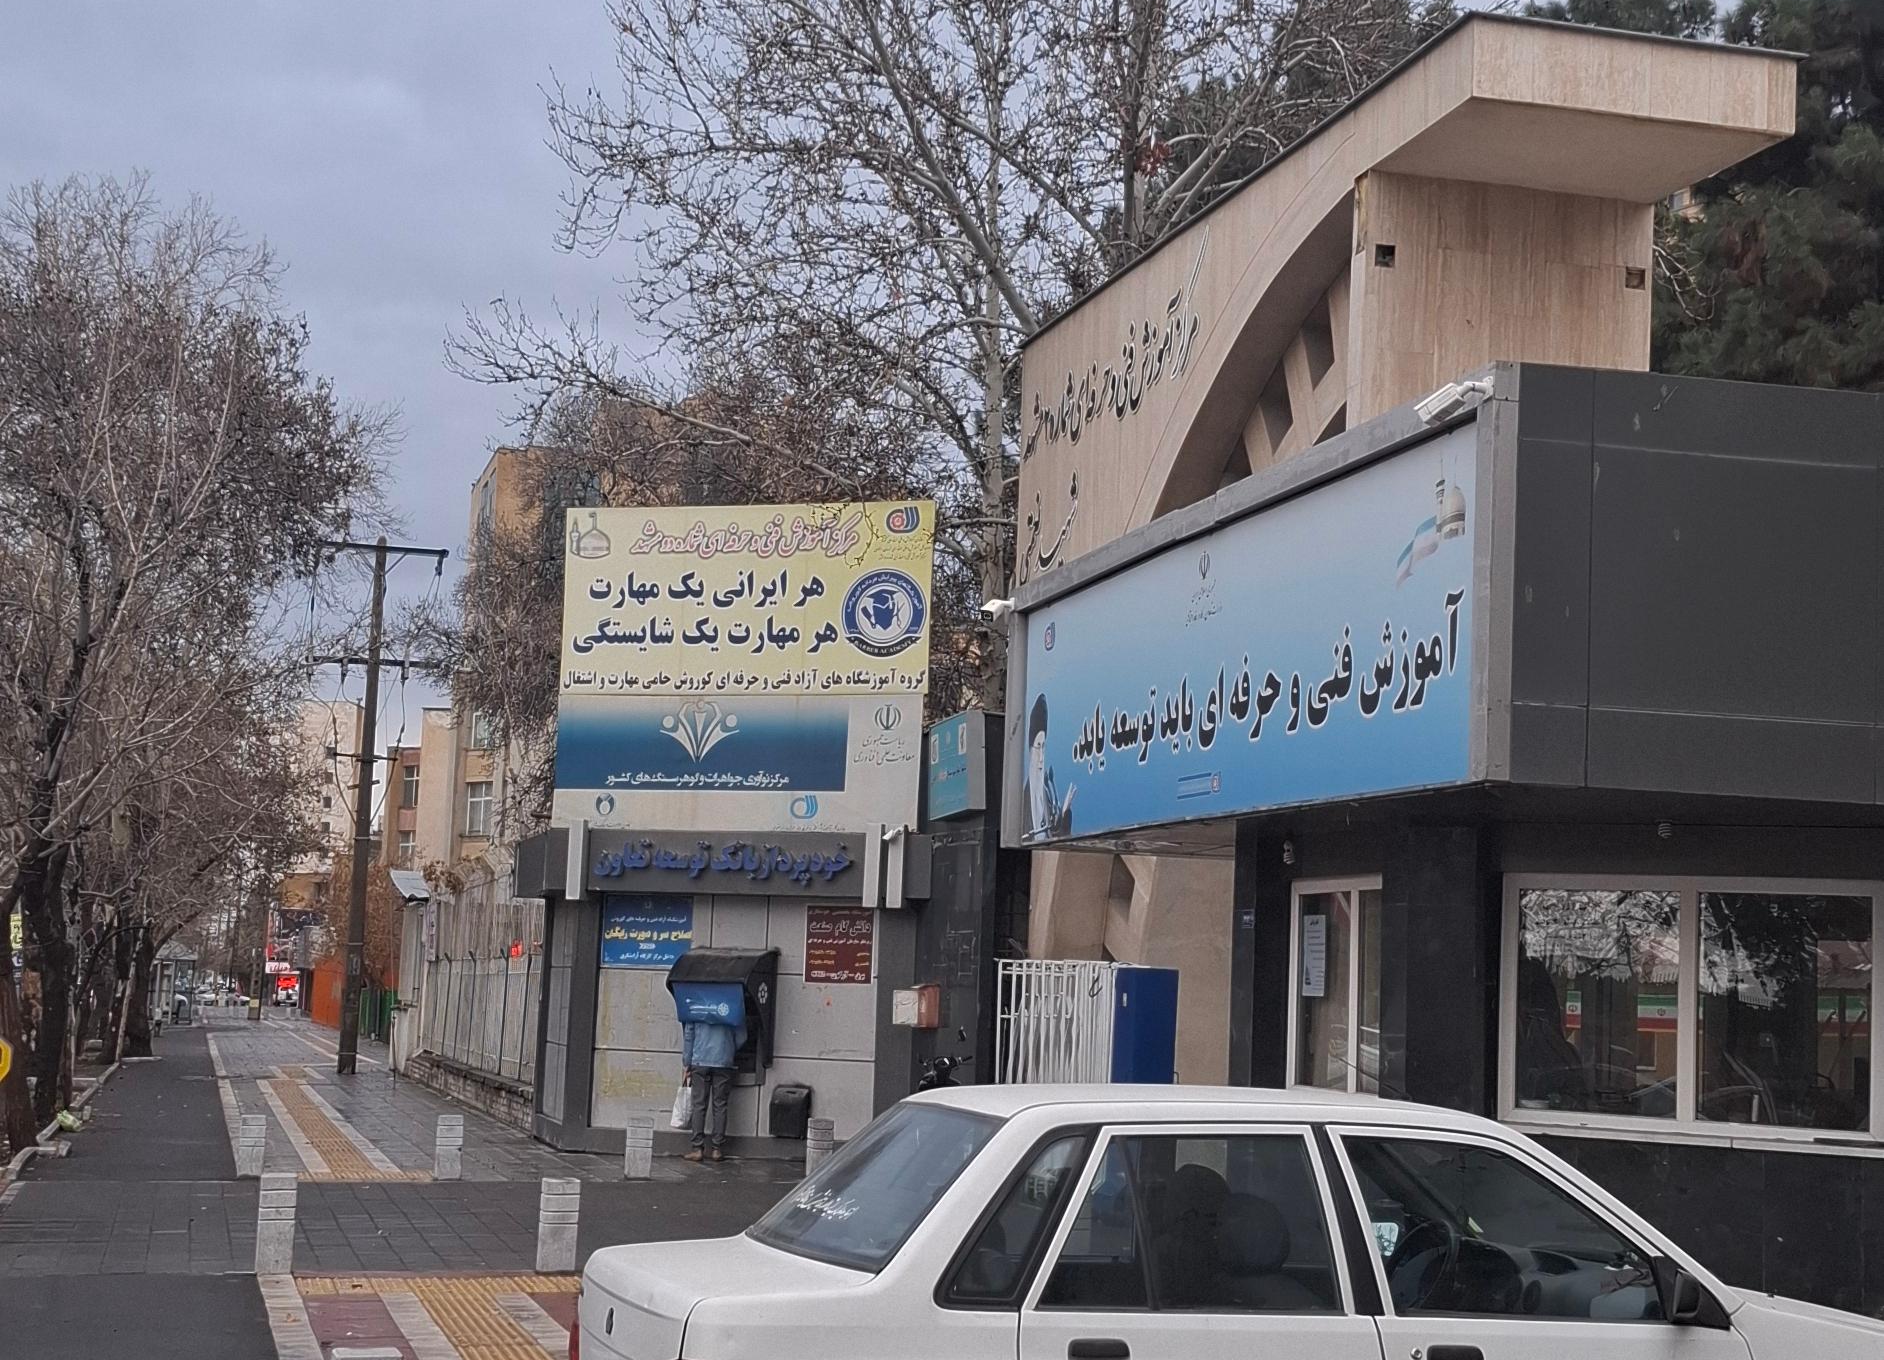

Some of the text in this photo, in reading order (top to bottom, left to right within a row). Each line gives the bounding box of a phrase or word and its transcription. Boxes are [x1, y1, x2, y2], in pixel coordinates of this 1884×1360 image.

[1171, 224, 1210, 381] مرکز
[1113, 320, 1137, 421] فنی
[1129, 285, 1184, 414] آموزش
[1050, 367, 1076, 444] شماره
[1069, 363, 1092, 445] ای
[1085, 360, 1114, 424] حرفه
[1107, 371, 1119, 413] و
[1022, 390, 1044, 463] مشهد
[629, 520, 663, 554] مشهد
[660, 536, 675, 552] دو
[673, 520, 706, 552] شماره
[698, 529, 726, 559] ای
[722, 522, 754, 553] حرفه
[757, 514, 784, 558] فنی
[778, 516, 839, 558] آموزش
[826, 511, 863, 557] مرکز
[589, 568, 826, 609] هر ایرانی یک مهارت
[572, 615, 840, 654] هر مهارت یک شایستگی
[1358, 588, 1466, 718] آموزش
[564, 668, 927, 690] گروه آموزشگاه های آزاد فنی و حرفه ای کوروش حامی مهارت و اشتغال
[1228, 653, 1282, 741] حرفه
[1306, 624, 1352, 729] فنی
[1110, 687, 1157, 765] توسعه
[1159, 677, 1194, 755] باید
[1198, 664, 1225, 751] ای
[1286, 672, 1301, 734] و
[605, 772, 632, 786] کشور
[705, 772, 743, 787] جواهرات
[743, 770, 770, 787] نوآوری
[768, 772, 789, 787] مرکز
[594, 838, 853, 886] خودپرداز بانک توسعه تعاون
